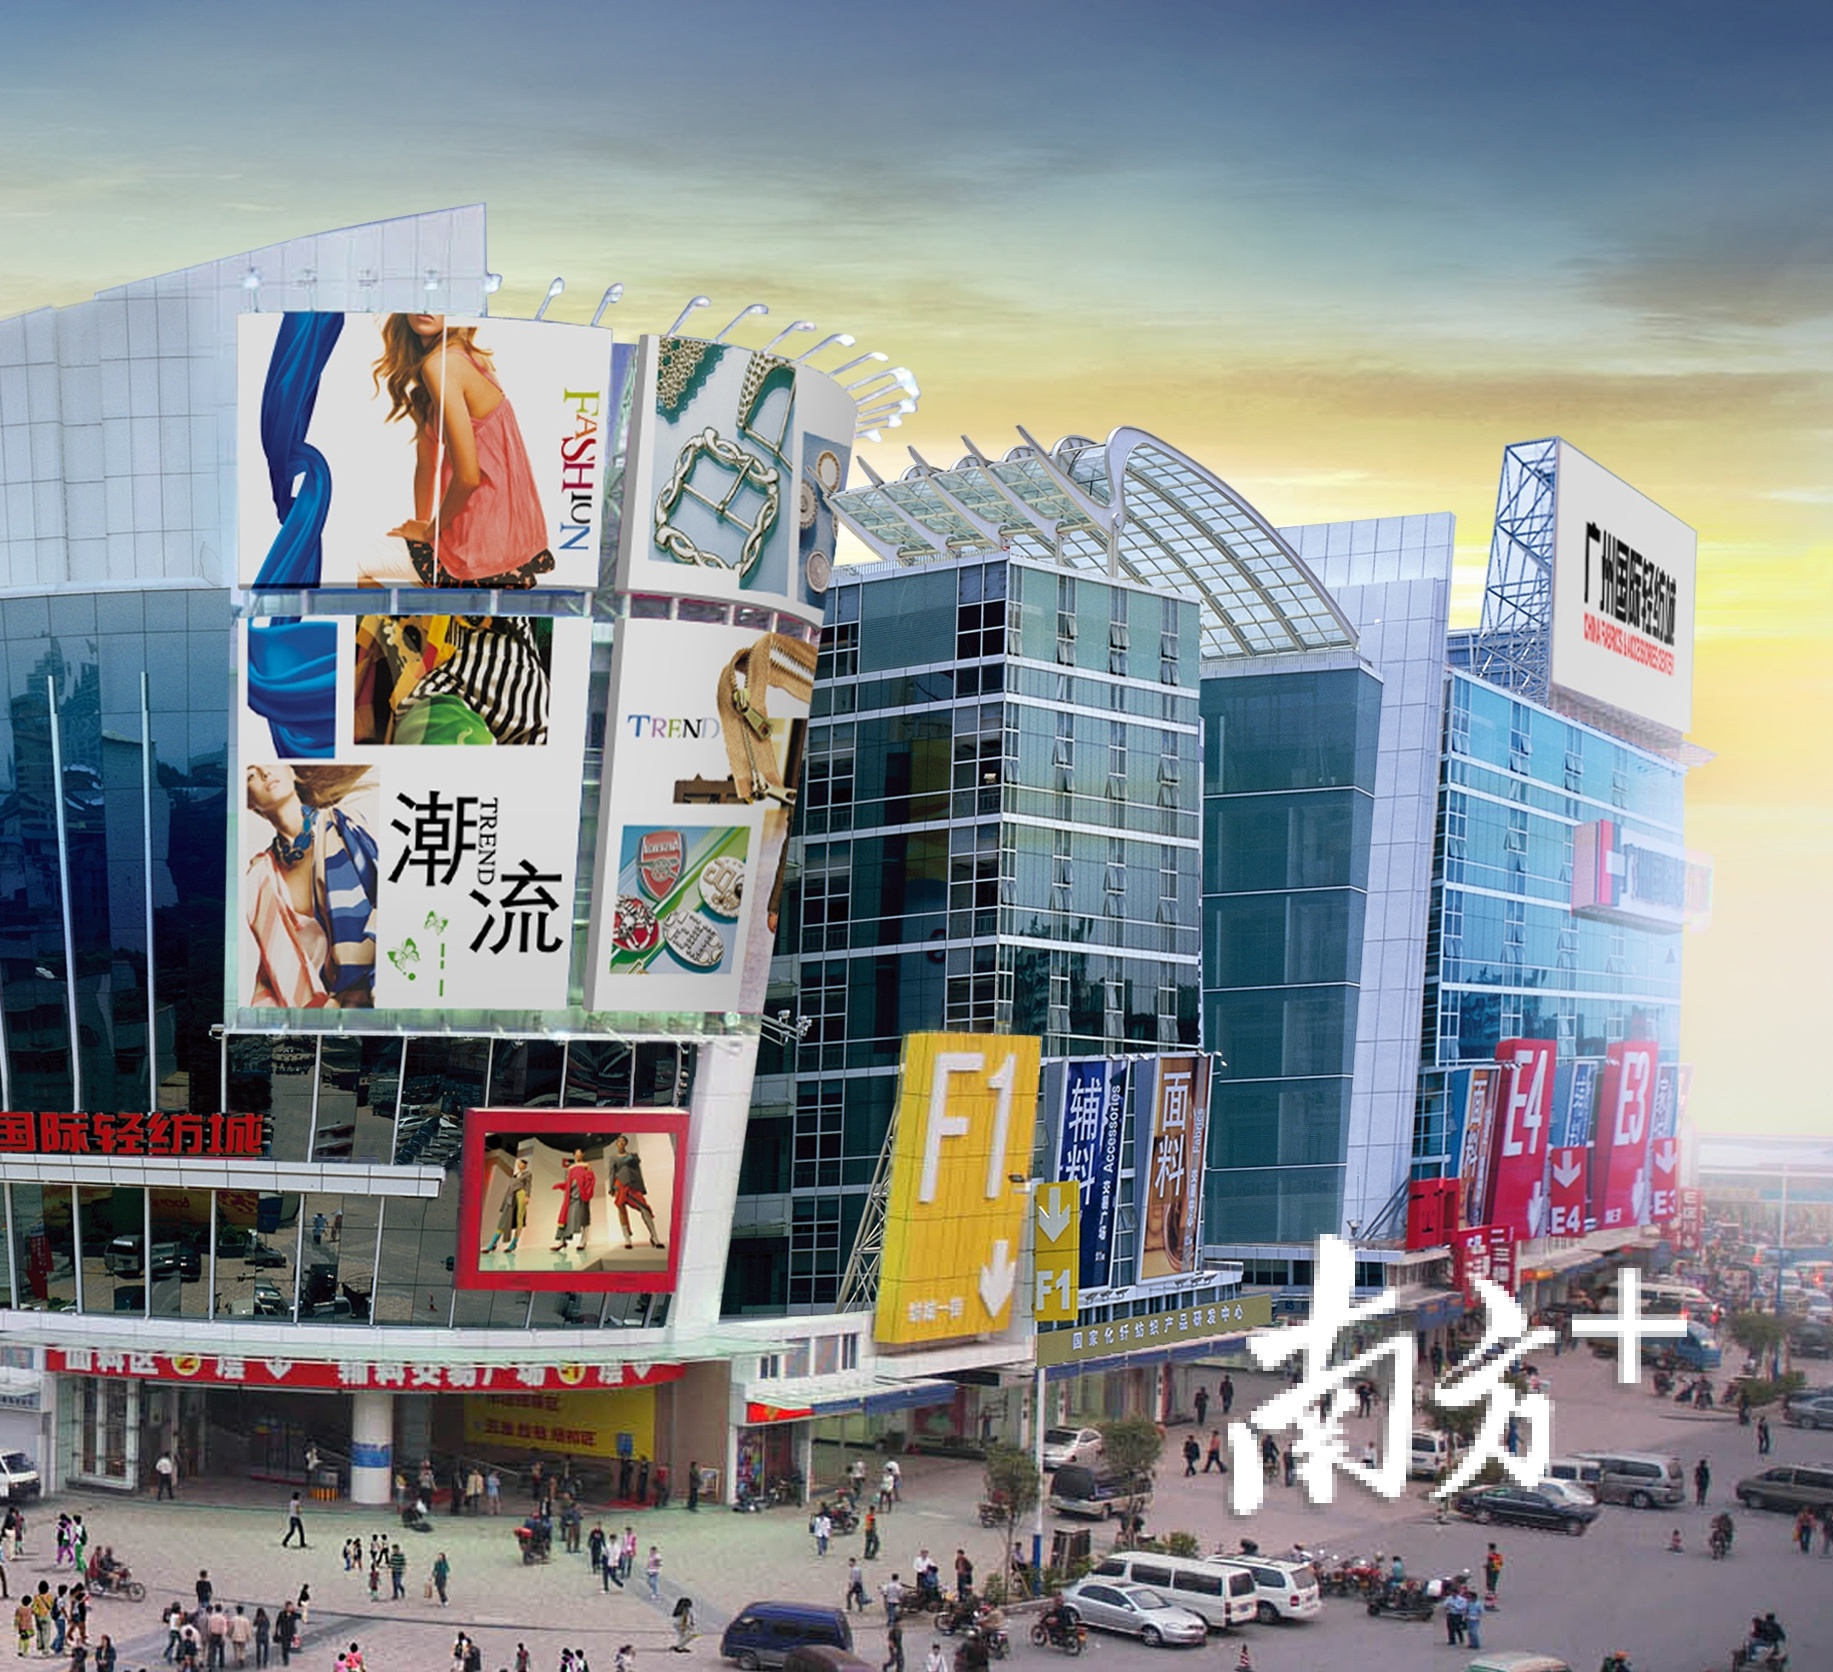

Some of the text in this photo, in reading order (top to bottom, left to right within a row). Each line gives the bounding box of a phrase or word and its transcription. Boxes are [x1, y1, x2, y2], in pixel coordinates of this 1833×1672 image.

[1584, 521, 1676, 646] 广州国际轻纺城
[626, 714, 720, 739] TREND
[477, 797, 498, 886] TREND
[919, 1052, 1017, 1205] F1
[1065, 1077, 1103, 1206] 辅料
[1103, 1084, 1122, 1174] Accessories
[1155, 1071, 1192, 1199] 面料
[1192, 1107, 1204, 1154] Fabrics
[1503, 1050, 1549, 1157] E4
[1613, 1051, 1650, 1147] E3
[1550, 1205, 1581, 1234] E4
[1036, 1269, 1070, 1311] F1
[1072, 1304, 1244, 1350] 国家化纤纺织产品研发中心
